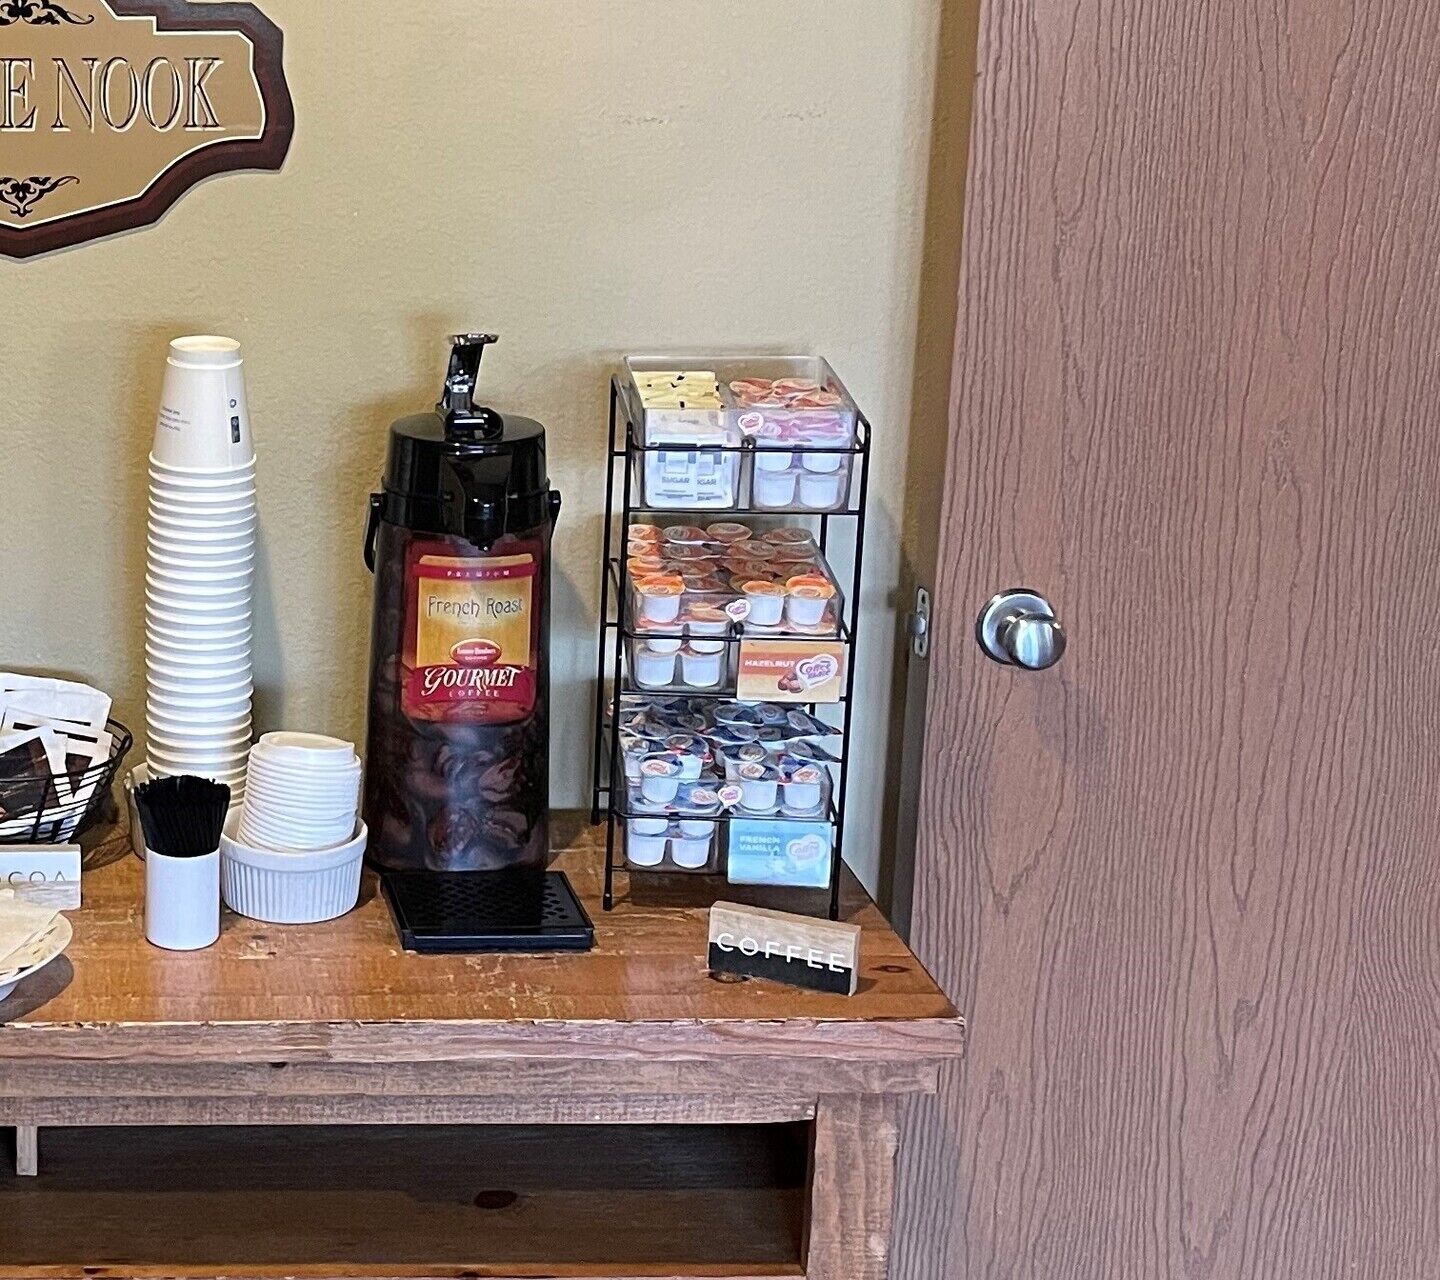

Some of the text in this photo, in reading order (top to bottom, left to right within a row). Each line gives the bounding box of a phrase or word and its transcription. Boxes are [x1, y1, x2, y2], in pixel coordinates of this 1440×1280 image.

[51, 56, 227, 134] NOOK
[428, 595, 523, 619] French Roast
[744, 660, 796, 668] HAZELNUT
[421, 666, 524, 696] GOURMET
[715, 932, 846, 973] COFFEE
